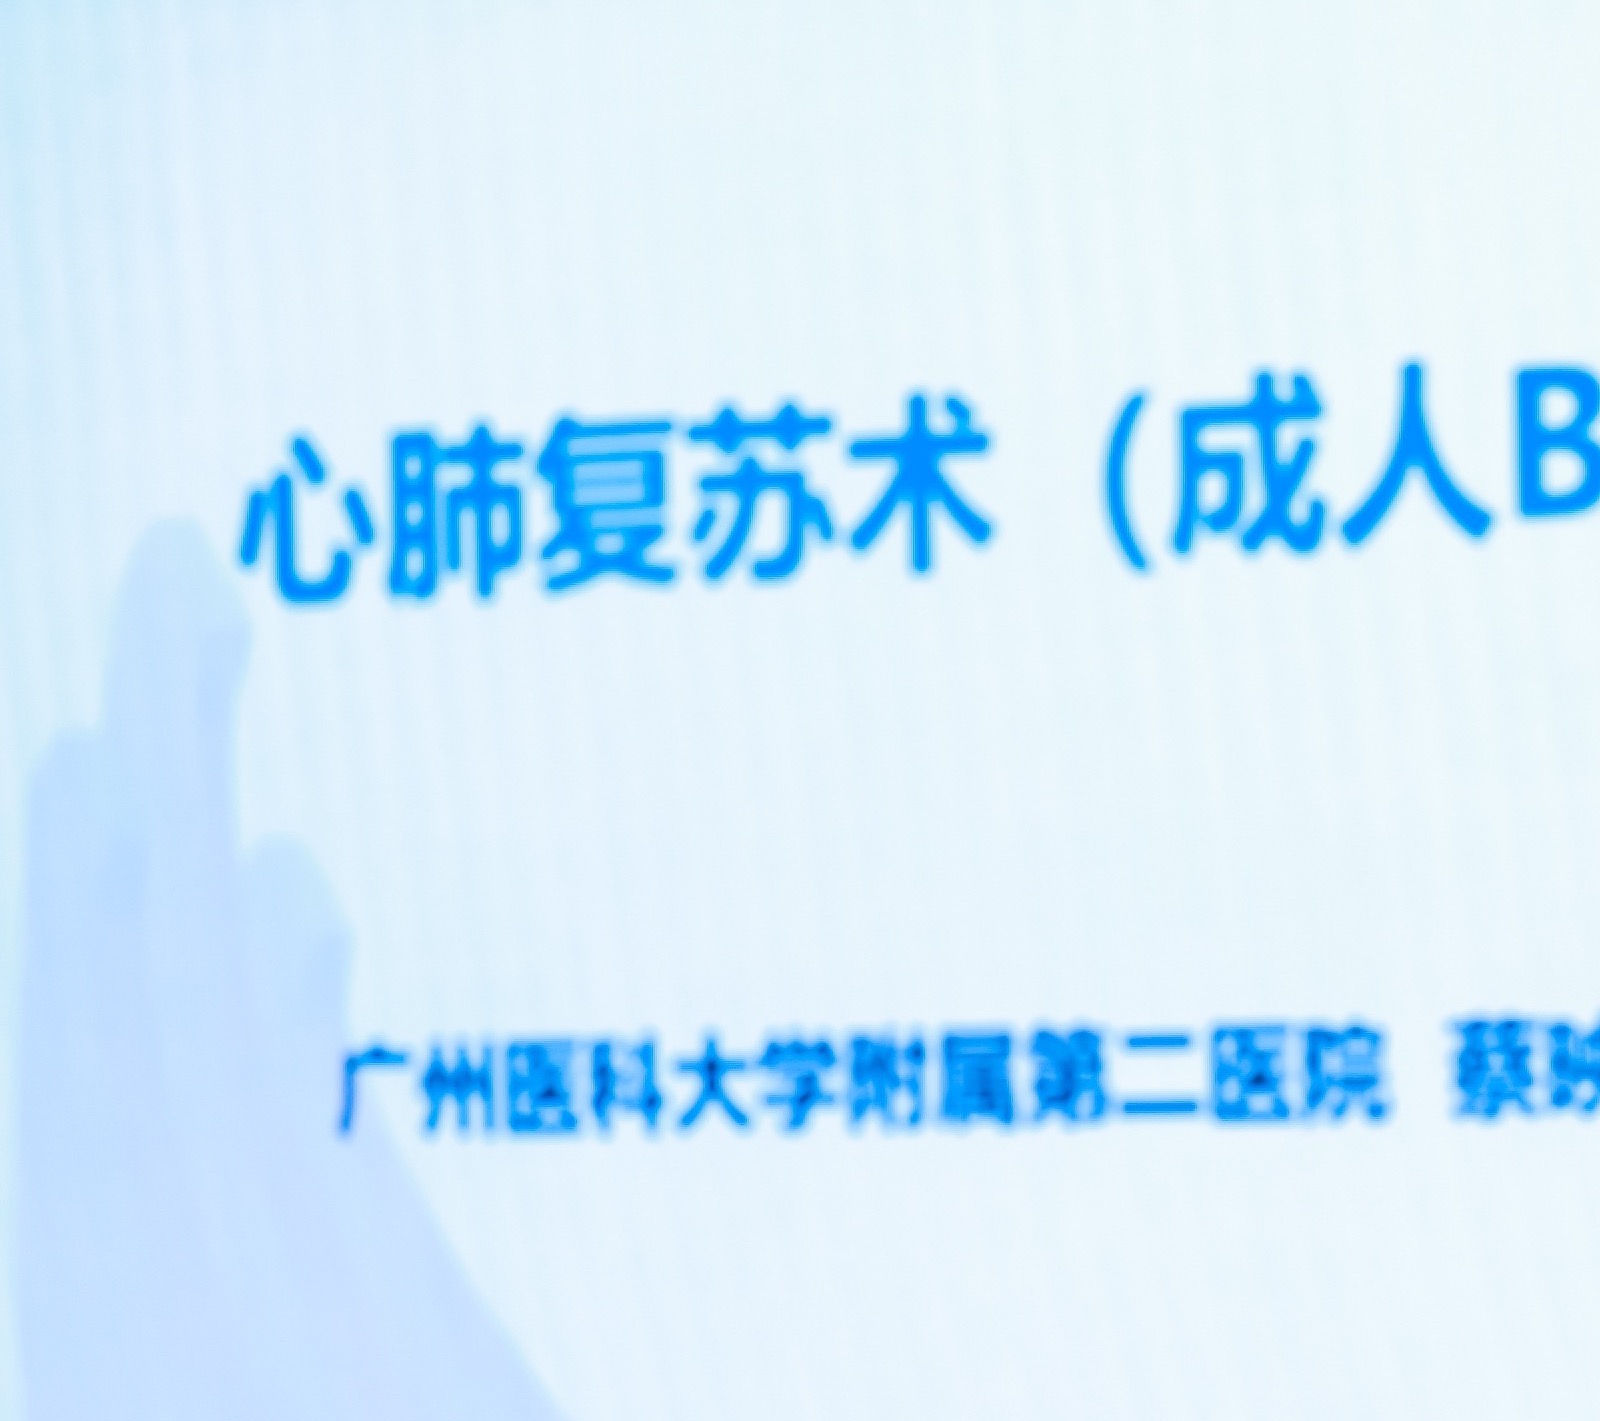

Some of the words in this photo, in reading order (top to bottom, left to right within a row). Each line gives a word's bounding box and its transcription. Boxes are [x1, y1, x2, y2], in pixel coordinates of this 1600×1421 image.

[339, 1020, 1389, 1136] 广州医科大学附属第二医院
